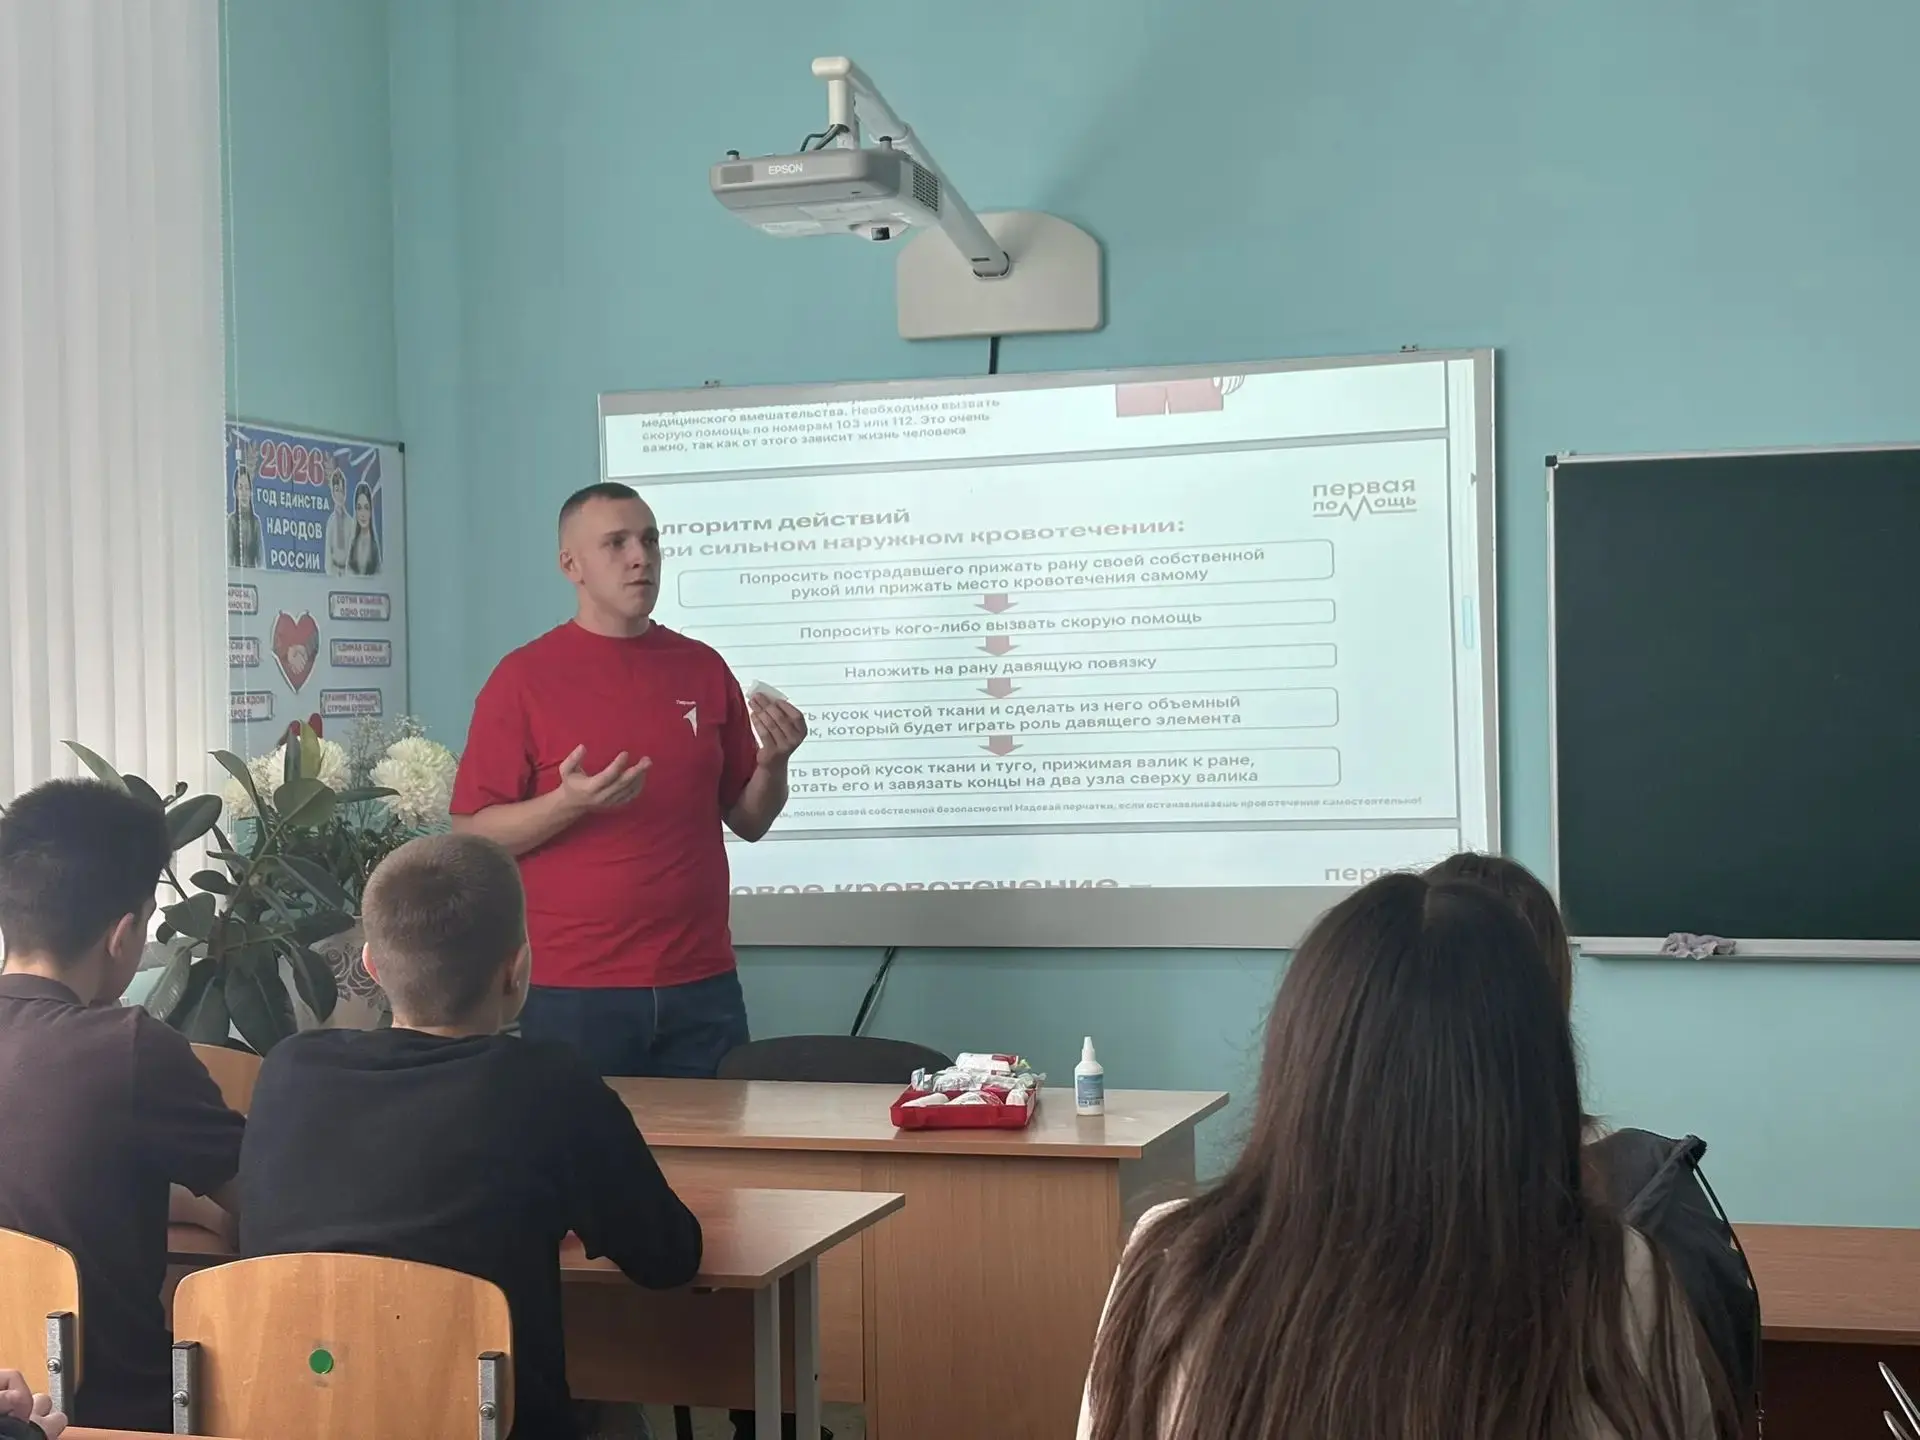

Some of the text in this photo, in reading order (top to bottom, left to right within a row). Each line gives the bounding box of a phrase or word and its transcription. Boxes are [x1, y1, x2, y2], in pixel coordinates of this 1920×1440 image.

[768, 162, 804, 176] EPSON
[642, 413, 737, 428] медицинского
[740, 408, 848, 422] вмешательства.
[852, 404, 938, 416] Необходимо
[942, 399, 1000, 411] вызвать
[642, 412, 990, 442] скорую помощь по номерам 103 или 112. Это очень
[642, 427, 966, 454] важно, так как от этого зависит жизнь человека
[258, 438, 325, 487] 2026
[256, 487, 330, 511] ГОД ЕДИНСТВА
[1312, 479, 1416, 499] первая
[266, 516, 323, 541] НАРОДОВ
[661, 508, 910, 537] лгоритм действий
[662, 520, 1185, 560] ри сильном наружном кровотечении:
[270, 549, 321, 570] РОССИИ
[739, 548, 1265, 587] Попросить пострадавшего прижать рану своей собственной
[791, 569, 1209, 600] рукой или прижать место кровотечения самому
[800, 612, 1202, 641] Попросить кого-либо вызвать скорую помощь
[844, 656, 1157, 679] Наложить на рану давящую повязку
[821, 710, 870, 723] кусок
[874, 706, 932, 720] чистой
[937, 705, 985, 717] ткани
[989, 705, 1000, 716] и
[1005, 702, 1075, 716] сделать
[1080, 702, 1099, 713] из
[1104, 700, 1143, 711] него
[1148, 695, 1241, 710] объемный
[828, 721, 900, 738] который
[903, 719, 952, 735] будет
[958, 720, 1015, 734] играть
[1020, 718, 1061, 732] роль
[1065, 714, 1152, 730] давящего
[1156, 713, 1241, 726] элемента
[812, 764, 870, 779] второй
[875, 763, 923, 777] кусок
[928, 763, 976, 774] ткани
[980, 762, 991, 772] и
[996, 761, 1037, 774] туго,
[1042, 757, 1132, 771] прижимая
[1137, 757, 1188, 768] валик
[1193, 756, 1203, 767] к
[1208, 753, 1255, 768] ране,
[842, 781, 870, 793] его
[874, 780, 884, 791] и
[888, 777, 963, 790] завязать
[967, 776, 1021, 789] концы
[1026, 776, 1045, 787] на
[1050, 775, 1081, 788] два
[1086, 774, 1125, 788] узла
[1130, 772, 1191, 786] сверху
[1196, 771, 1258, 783] валика
[868, 806, 934, 816] собственной
[1118, 802, 1146, 811] если
